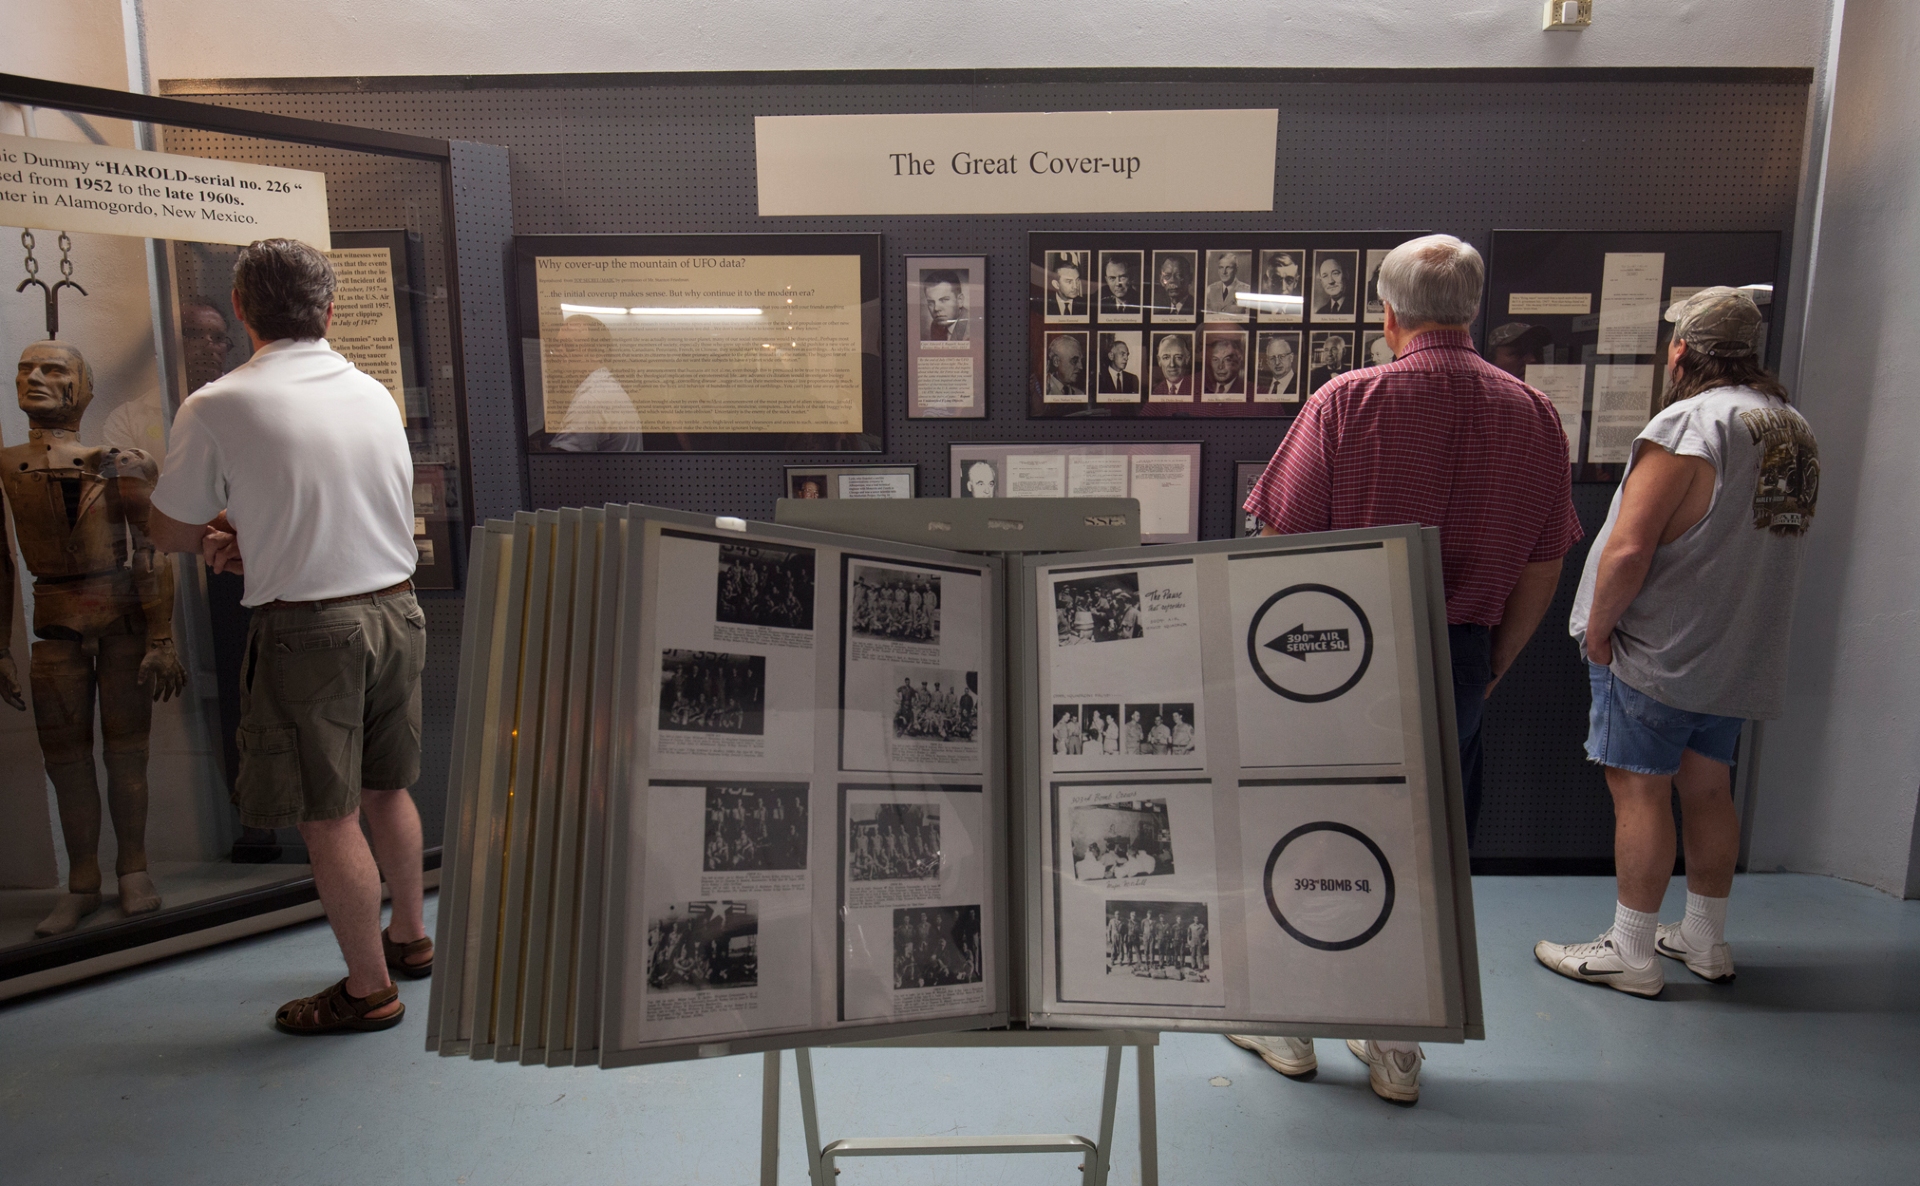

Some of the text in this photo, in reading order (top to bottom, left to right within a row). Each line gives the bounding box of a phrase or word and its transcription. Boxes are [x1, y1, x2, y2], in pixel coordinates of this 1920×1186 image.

[890, 150, 1141, 179] The Great Cover-up
[0, 149, 17, 163] ic
[23, 152, 90, 174] Dummy
[240, 180, 261, 191] no.
[266, 180, 291, 193] 226
[28, 172, 69, 188] from
[75, 177, 113, 193] 1952
[118, 183, 133, 195] to
[138, 184, 161, 198] the
[165, 187, 194, 201] late
[199, 191, 245, 206] 1960s.
[33, 191, 48, 205] in
[54, 194, 158, 217] Alamogordo,
[162, 204, 196, 219] New
[201, 208, 258, 225] Mexico.
[538, 258, 746, 272] Why cover-up the mountain of UFO data?
[564, 290, 586, 298] initial
[588, 291, 618, 300] coverup
[620, 290, 644, 298] makes
[670, 290, 682, 298] But
[684, 290, 700, 299] why
[333, 302, 359, 310] appened
[355, 310, 383, 318] clippings
[338, 319, 352, 327] July
[352, 319, 360, 327] of
[349, 352, 367, 360] flying
[1320, 632, 1340, 641] AIR
[1286, 640, 1348, 652] SERVICE SQ.
[1320, 878, 1352, 892] BOMB
[1354, 879, 1372, 893] SQ.
